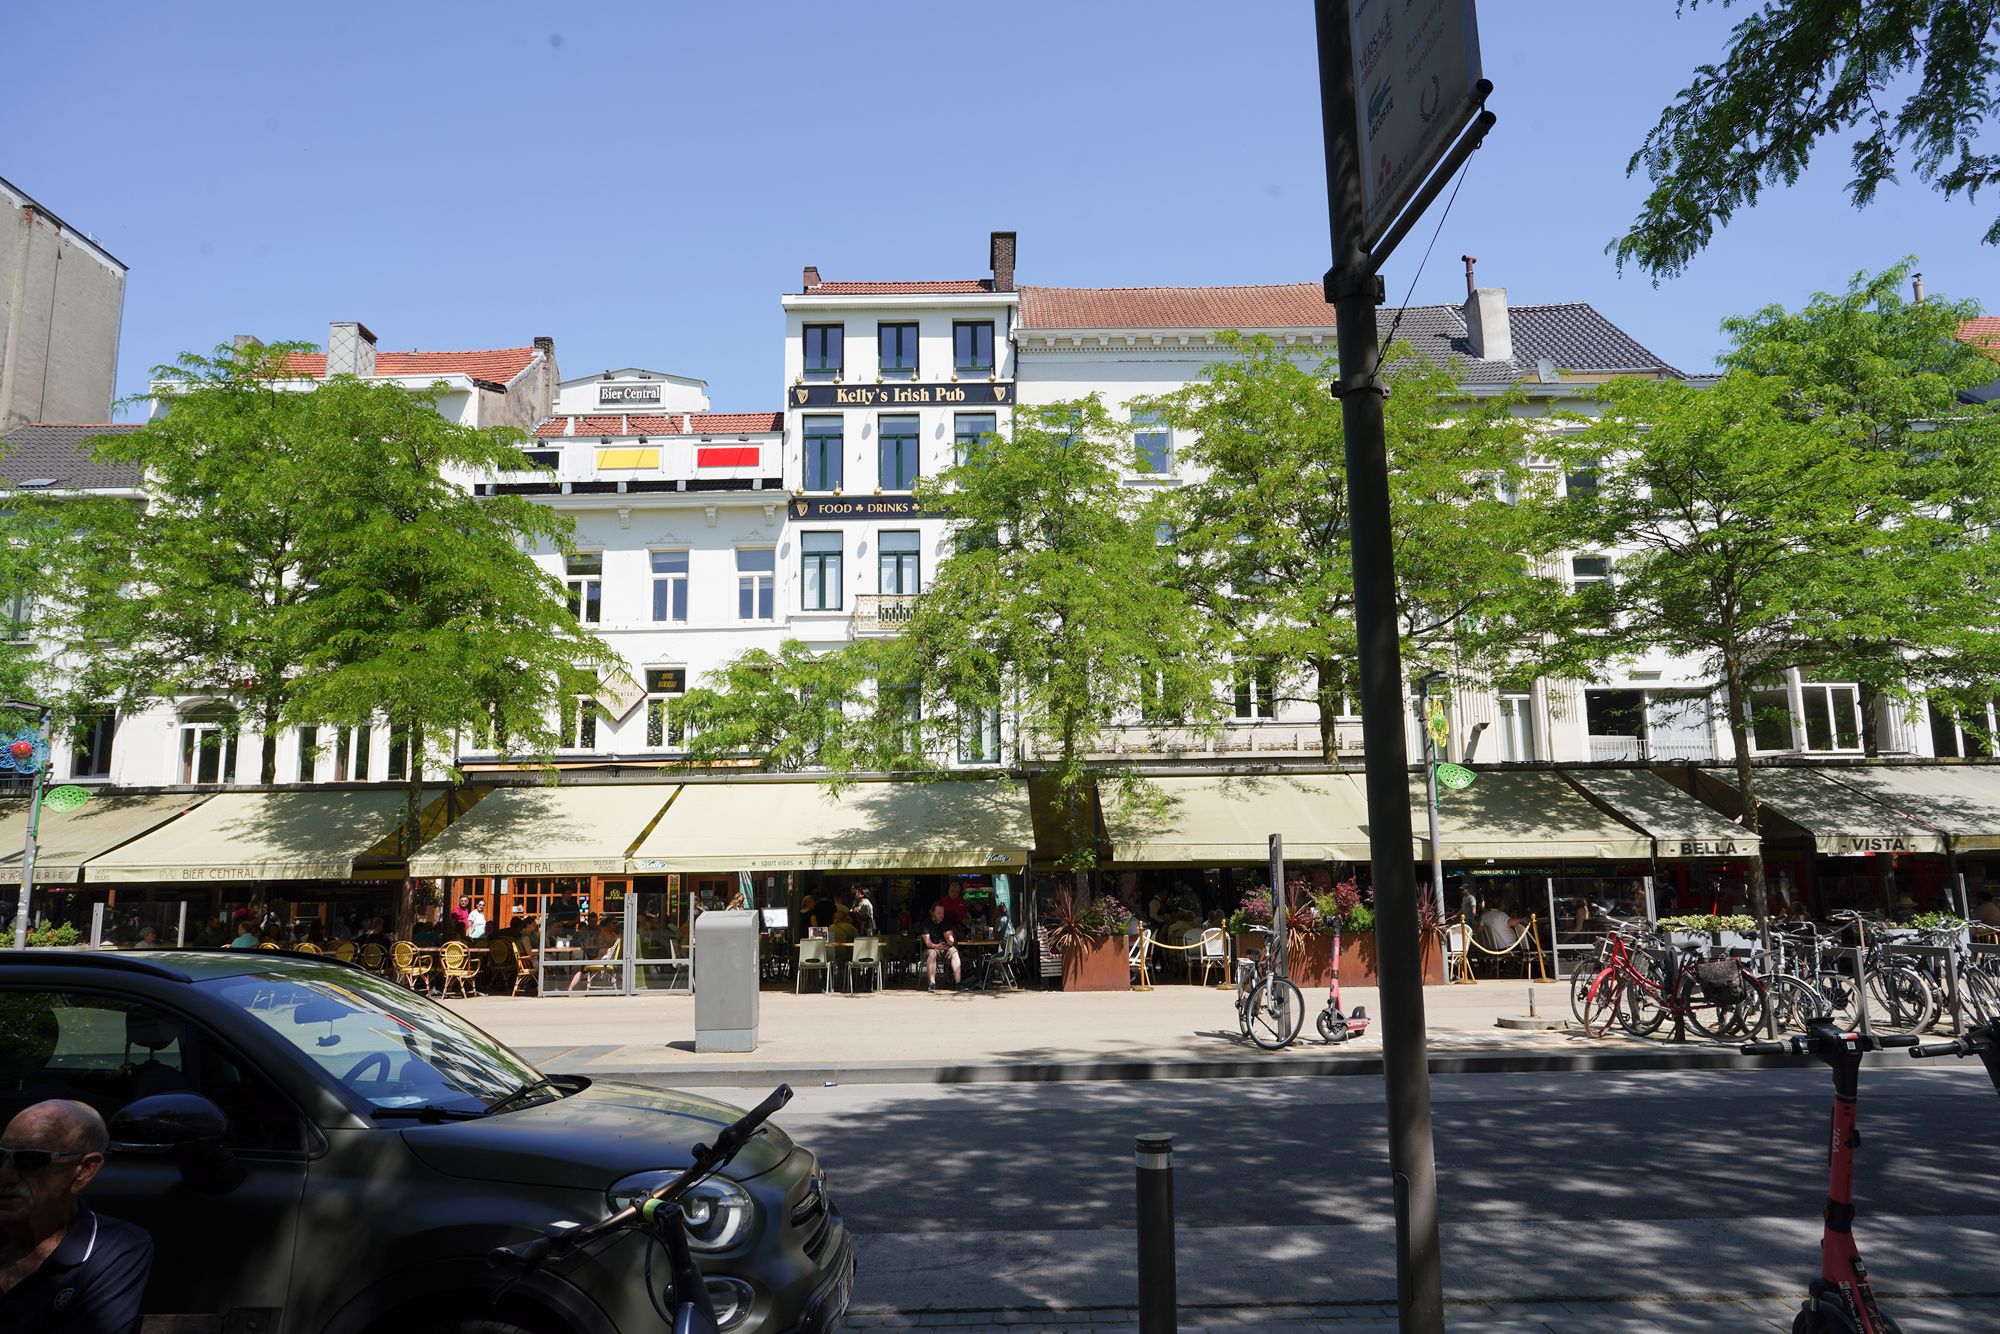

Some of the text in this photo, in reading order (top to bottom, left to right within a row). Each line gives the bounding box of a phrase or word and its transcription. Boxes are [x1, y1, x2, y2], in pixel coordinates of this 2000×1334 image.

[1358, 7, 1392, 71] VERSACE
[1368, 96, 1394, 142] LACOSTE
[601, 386, 660, 400] Bier Central
[836, 387, 966, 406] Kelly's Irish Pub
[818, 504, 853, 514] FOOD
[867, 503, 909, 513] DRINKS
[1680, 842, 1738, 855] BELLA
[1852, 838, 1905, 851] VISTA
[182, 868, 256, 880] BIER CENTRAL
[479, 862, 554, 874] BIER CENTRAL
